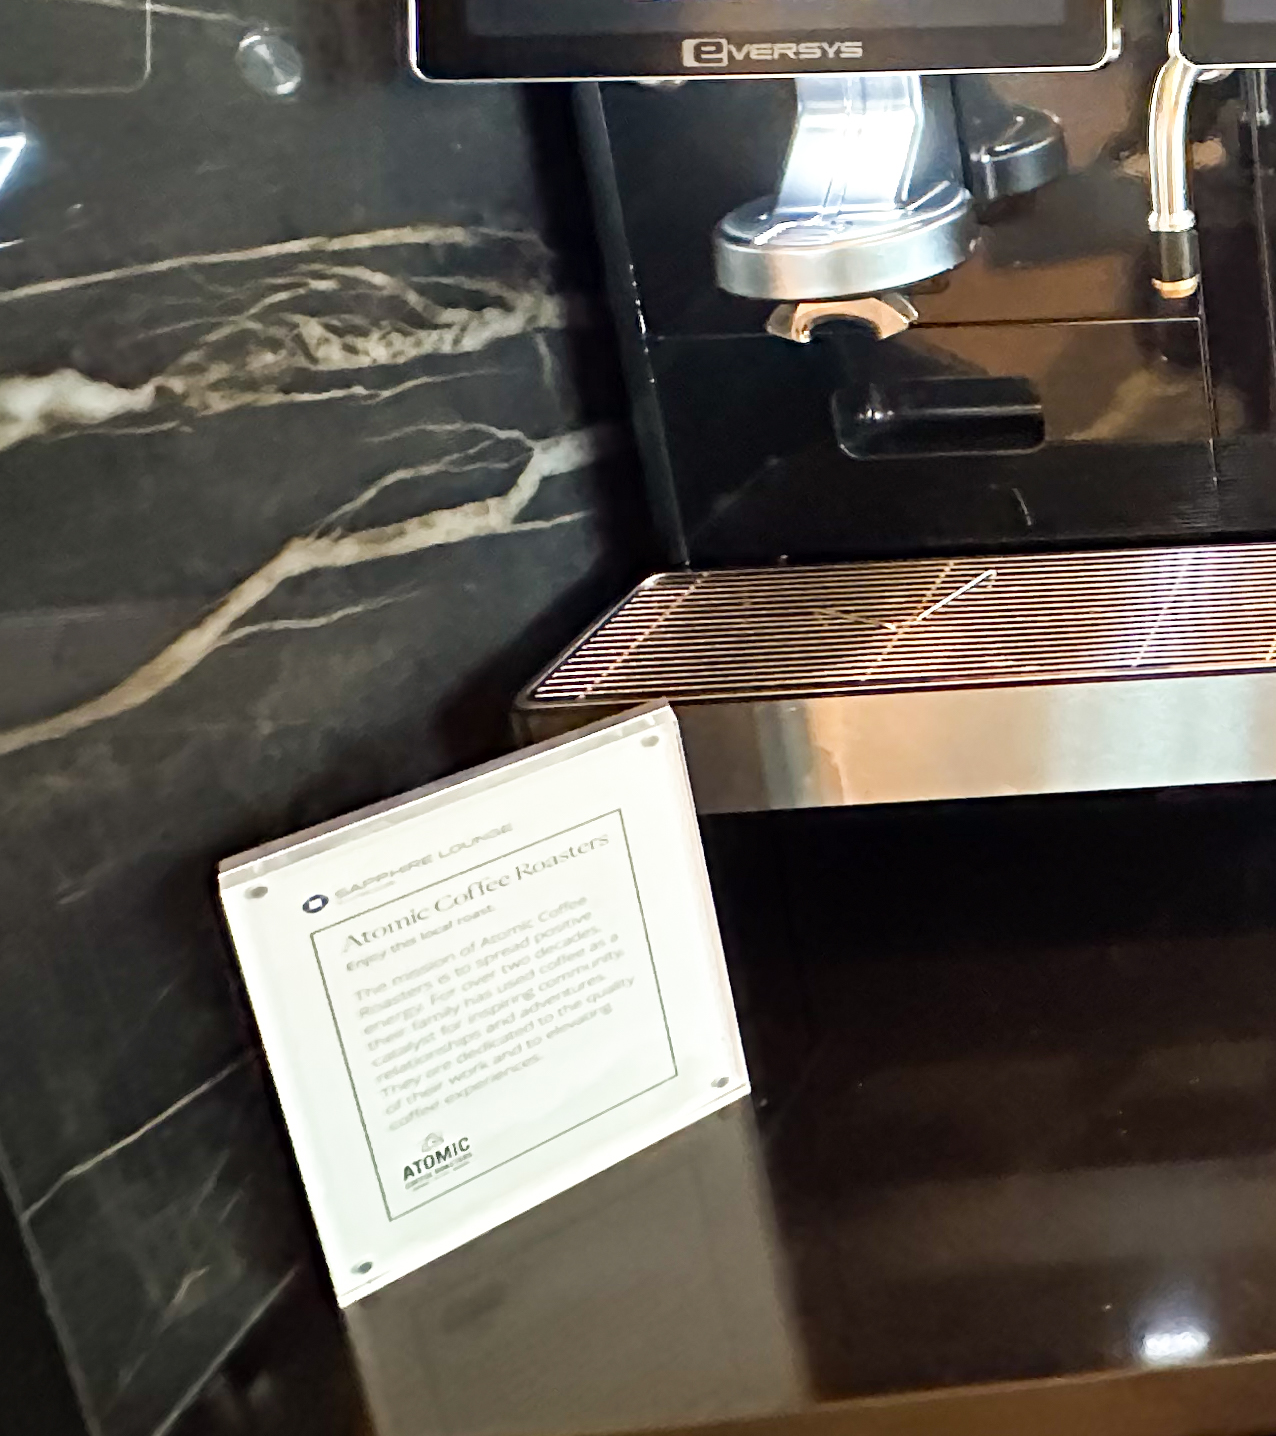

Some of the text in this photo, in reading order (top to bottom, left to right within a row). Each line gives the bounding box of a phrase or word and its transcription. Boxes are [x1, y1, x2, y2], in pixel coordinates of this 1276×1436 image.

[334, 853, 433, 901] SAPPHIRE
[341, 907, 430, 953] Atomic
[432, 874, 510, 912] Coffee
[514, 833, 609, 881] Roasters
[345, 948, 387, 972] Enjoy
[419, 919, 453, 940] local
[353, 982, 387, 1001] The
[402, 1136, 470, 1182] ATOMIC
